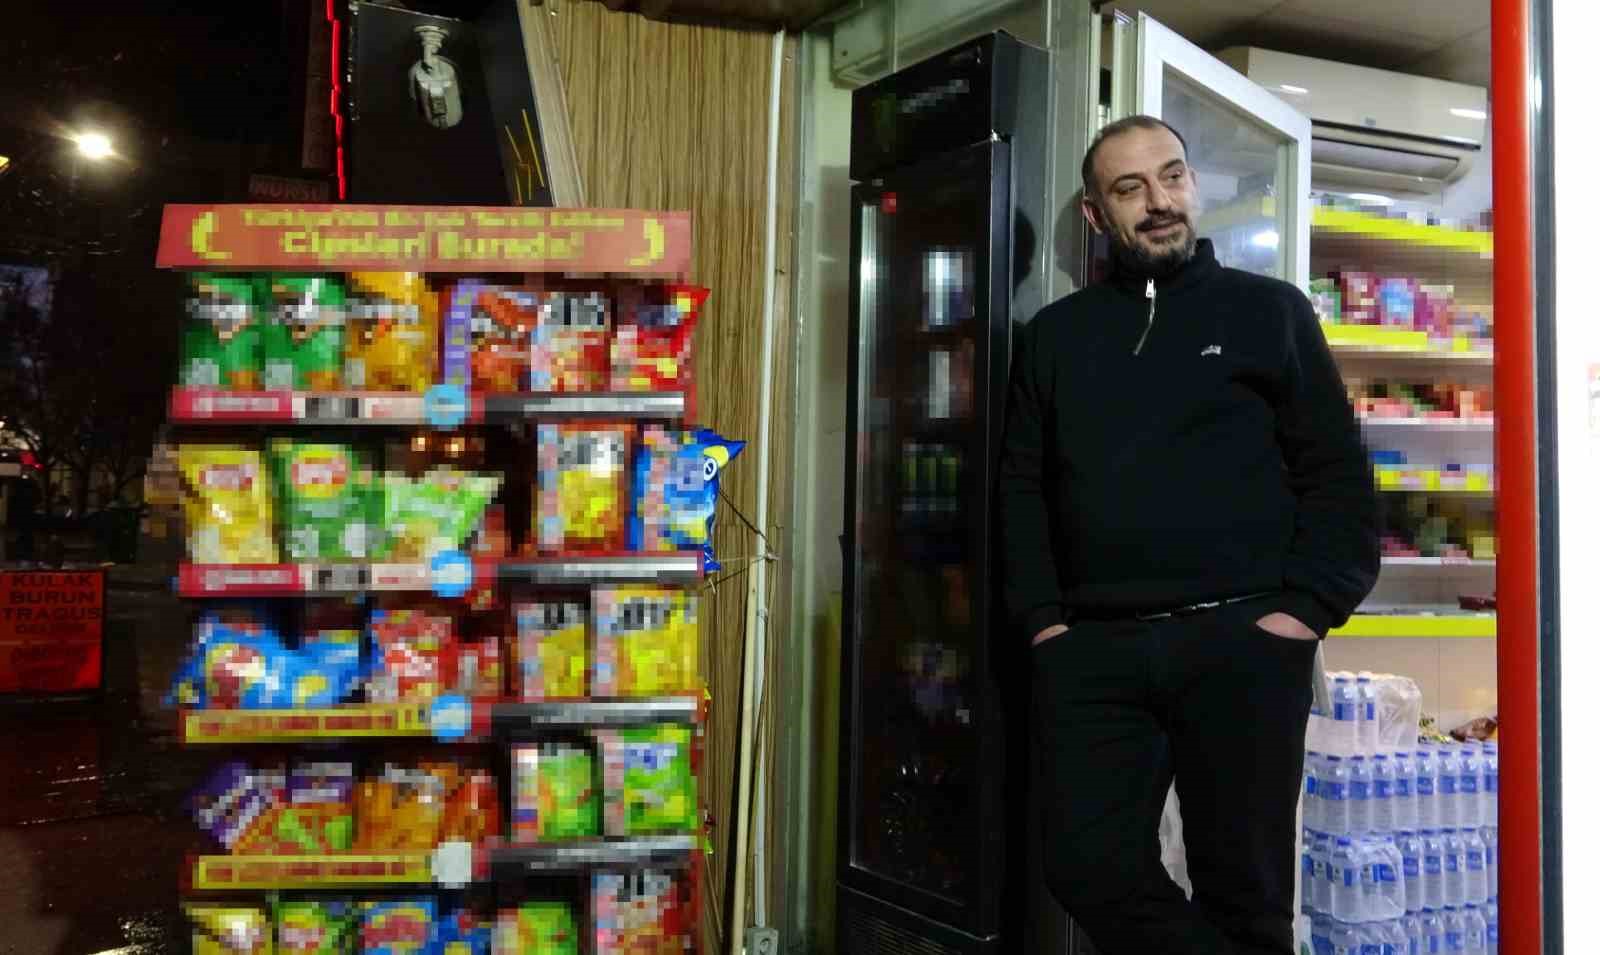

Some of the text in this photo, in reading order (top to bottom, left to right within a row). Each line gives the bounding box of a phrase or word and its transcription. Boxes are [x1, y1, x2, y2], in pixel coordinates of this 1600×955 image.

[13, 574, 92, 588] KULAK
[10, 592, 96, 605] BURUN
[2, 608, 102, 622] TRAGUS
